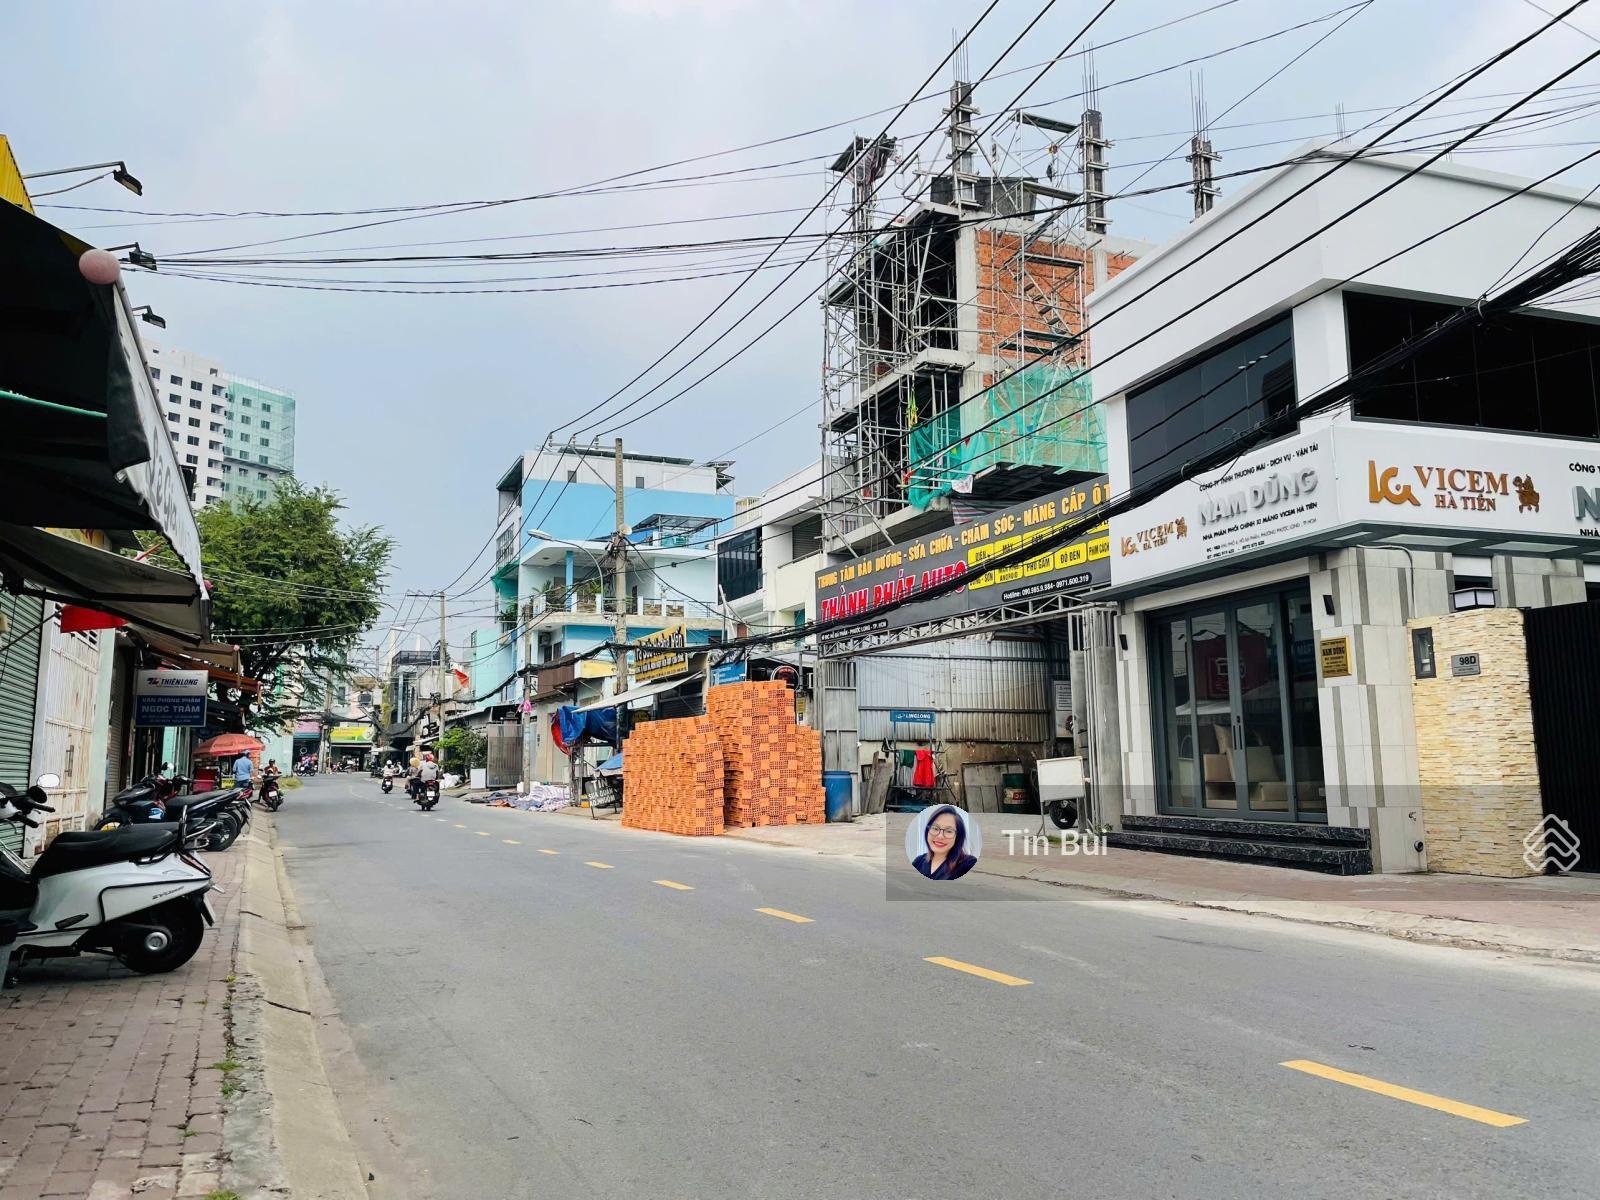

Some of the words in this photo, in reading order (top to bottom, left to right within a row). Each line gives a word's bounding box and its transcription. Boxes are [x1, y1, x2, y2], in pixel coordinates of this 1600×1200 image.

[1569, 461, 1596, 474] CÔNG
[1413, 465, 1509, 496] VICEM
[1198, 490, 1248, 526] NAM
[1251, 467, 1319, 509] DŨNG
[1435, 493, 1458, 509] HÀ
[840, 564, 854, 583] TÂM
[858, 557, 872, 577] BẢO
[908, 543, 926, 562] SỬA
[930, 532, 953, 555] CHỮA
[962, 522, 990, 546] CHĂM
[994, 510, 1015, 536] SÓC
[1024, 503, 1056, 527] NÂNG
[1062, 487, 1086, 514] CẤP
[1092, 482, 1103, 505] Ô
[1136, 522, 1174, 543] VICEM
[820, 584, 869, 622] THÀNH
[873, 568, 916, 608] PHÁT
[920, 560, 968, 594] AUTO
[1003, 590, 1021, 600] Hotline:
[1459, 656, 1476, 666] 98D
[142, 705, 170, 713] NGỌC
